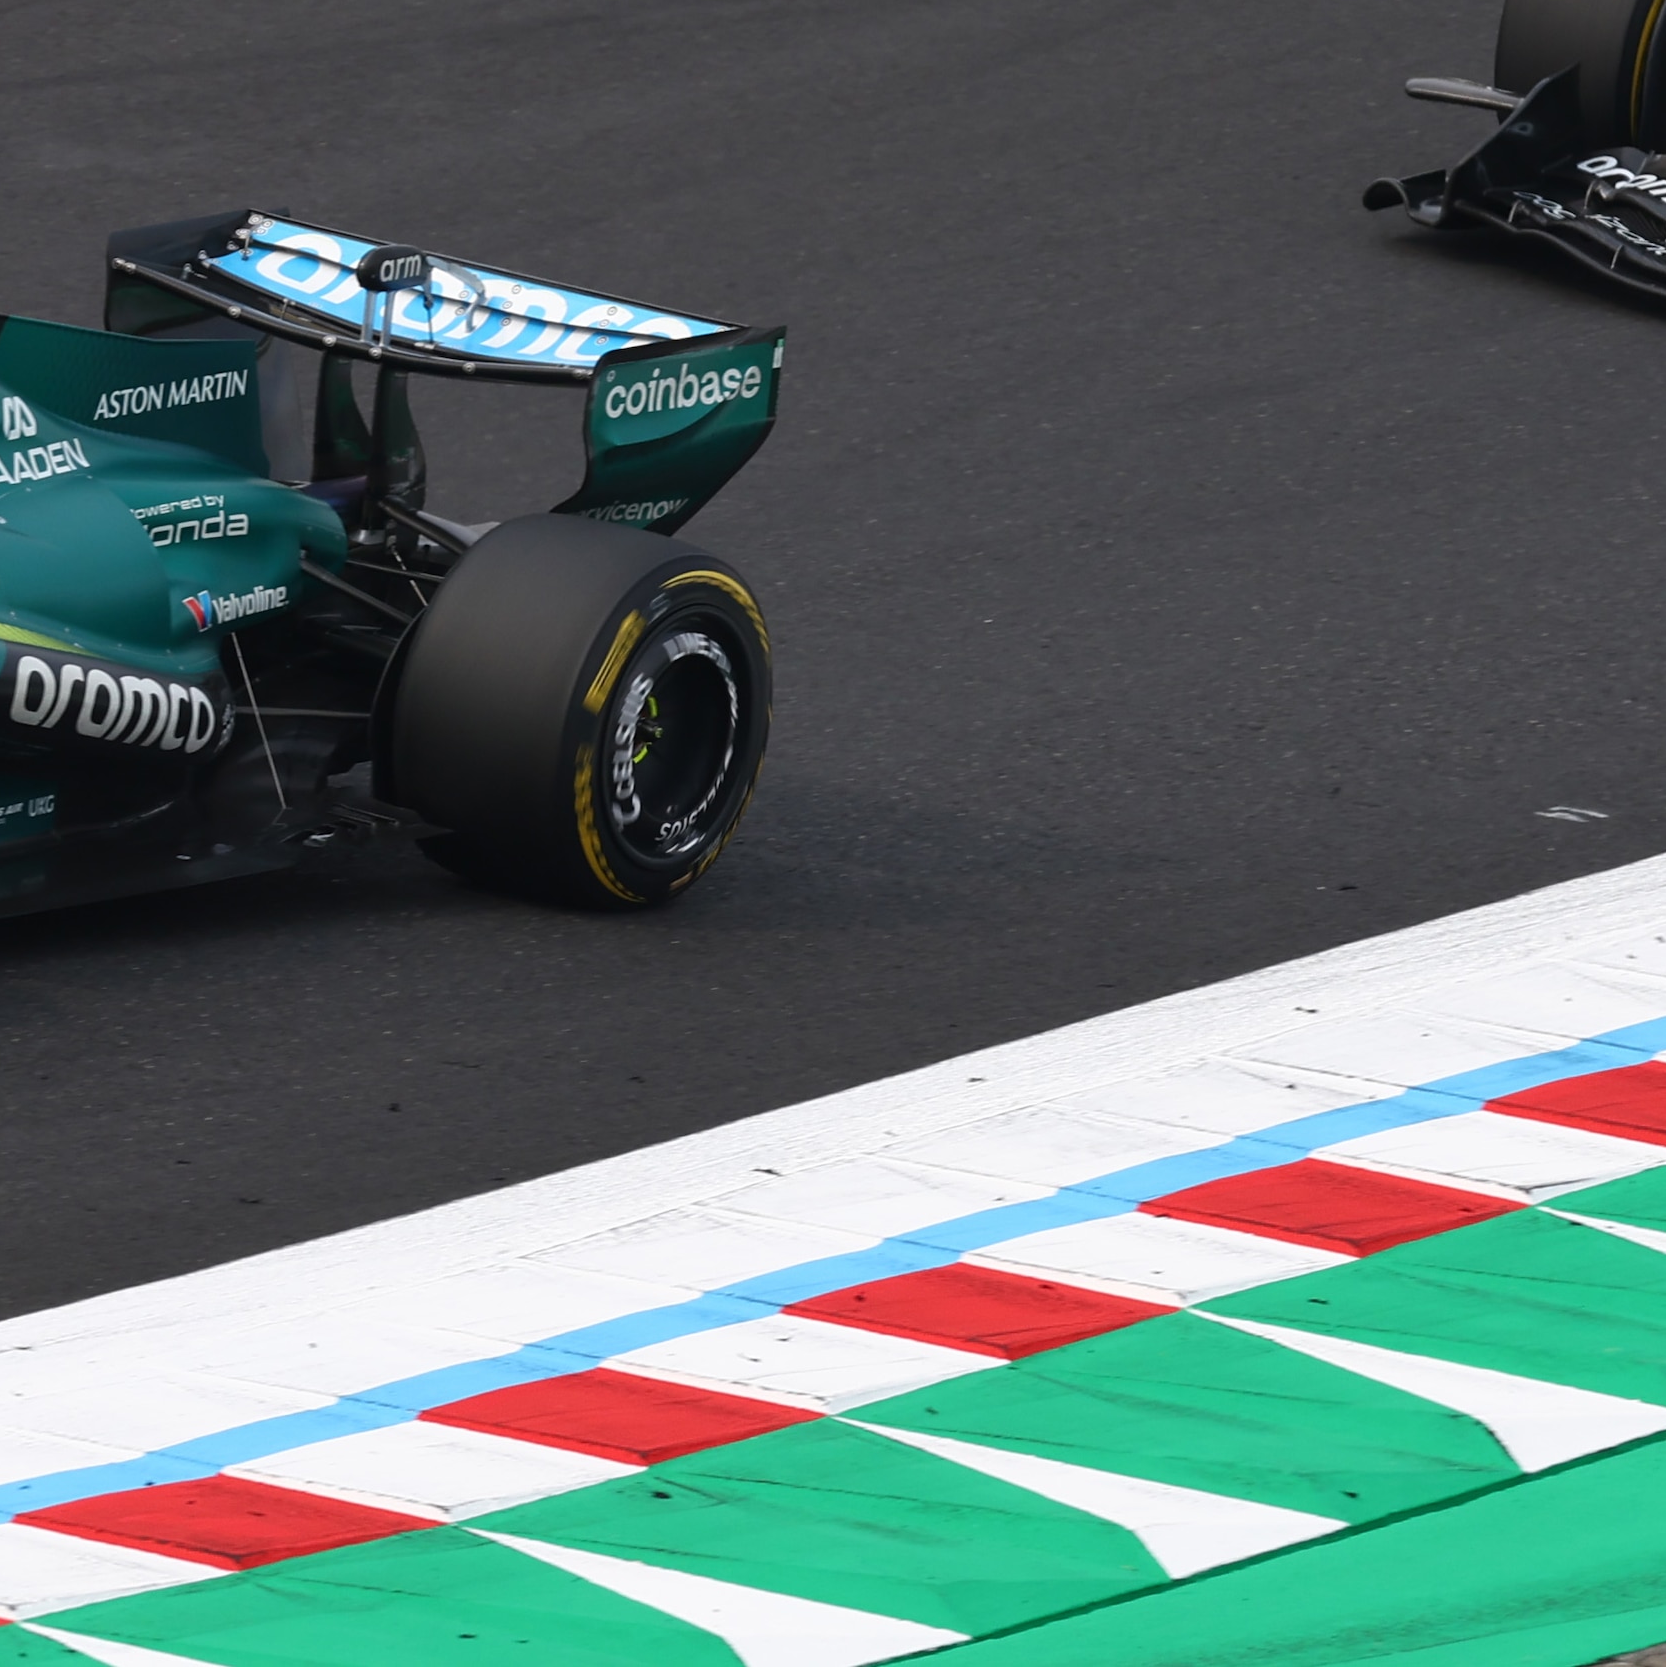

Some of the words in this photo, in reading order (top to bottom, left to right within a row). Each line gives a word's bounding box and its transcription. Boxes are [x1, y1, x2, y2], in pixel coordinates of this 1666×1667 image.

[379, 253, 423, 283] arm
[93, 383, 165, 421] ASTON
[166, 368, 249, 409] MARTIN
[604, 363, 763, 419] coinbase
[203, 494, 225, 508] by
[9, 655, 217, 754] aramco
[5, 802, 24, 816] AIR
[27, 794, 56, 818] UKG
